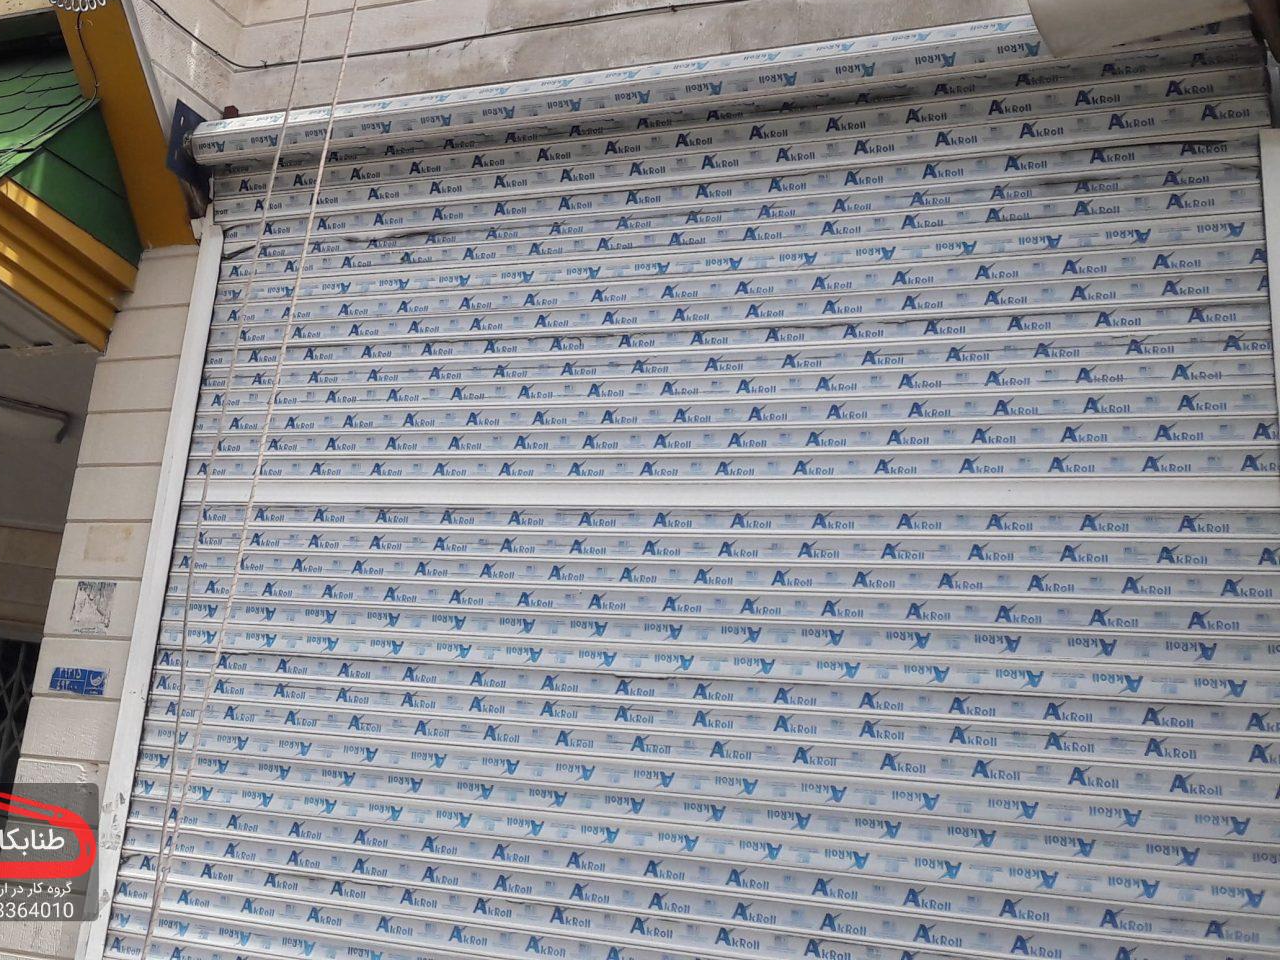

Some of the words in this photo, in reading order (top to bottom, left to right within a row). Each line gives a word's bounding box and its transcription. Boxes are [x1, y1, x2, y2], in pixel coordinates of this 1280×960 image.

[325, 435, 354, 451] AkRoll
[386, 434, 418, 450] AkRoll
[447, 435, 482, 450] AkRoll
[514, 434, 549, 450] AkRoll
[583, 433, 616, 450] AkRoll
[652, 432, 691, 449] AkRoll
[728, 431, 768, 448] AkRoll
[805, 430, 847, 447] AkRoll
[887, 429, 930, 446] AkRoll
[971, 426, 1017, 445] AkRoll
[1060, 425, 1108, 443] AkRoll
[1153, 424, 1204, 442] AkRoll
[293, 557, 321, 573] AkRoll
[351, 559, 384, 575] AkRoll
[416, 560, 448, 577] AkRoll
[479, 562, 515, 579] AkRoll
[548, 563, 585, 581] AkRoll
[618, 564, 657, 584] AkRoll
[693, 567, 734, 585] AkRoll
[771, 567, 813, 587] AkRoll
[853, 569, 896, 589] AkRoll
[938, 571, 984, 590] AkRoll
[1027, 574, 1075, 593] AkRoll
[1121, 574, 1172, 596] AkRoll
[1220, 577, 1273, 598] AkRoll
[214, 679, 245, 696] AkRoll
[273, 682, 306, 700] AkRoll
[335, 687, 369, 704] AkRoll
[402, 690, 436, 709] AkRoll
[469, 695, 506, 714] AkRoll
[539, 701, 578, 719] AkRoll
[614, 704, 654, 724] AkRoll
[693, 708, 734, 729] AkRoll
[772, 713, 818, 735] AkRoll
[858, 719, 905, 741] AkRoll
[948, 725, 998, 747] AkRoll
[1044, 730, 1096, 754] AkRoll
[1143, 737, 1197, 760] AkRoll
[227, 813, 259, 832] AkRoll
[288, 821, 322, 840] AkRoll
[352, 828, 389, 848] AkRoll
[421, 834, 458, 855] AkRoll
[491, 843, 531, 863] AkRoll
[566, 849, 606, 872] AkRoll
[643, 858, 686, 881] AkRoll
[724, 867, 770, 890] AkRoll
[811, 877, 859, 900] AkRoll
[902, 887, 952, 912] AkRoll
[999, 898, 1050, 922] AkRoll
[1099, 907, 1153, 932] AkRoll
[1204, 918, 1260, 943] AkRoll
